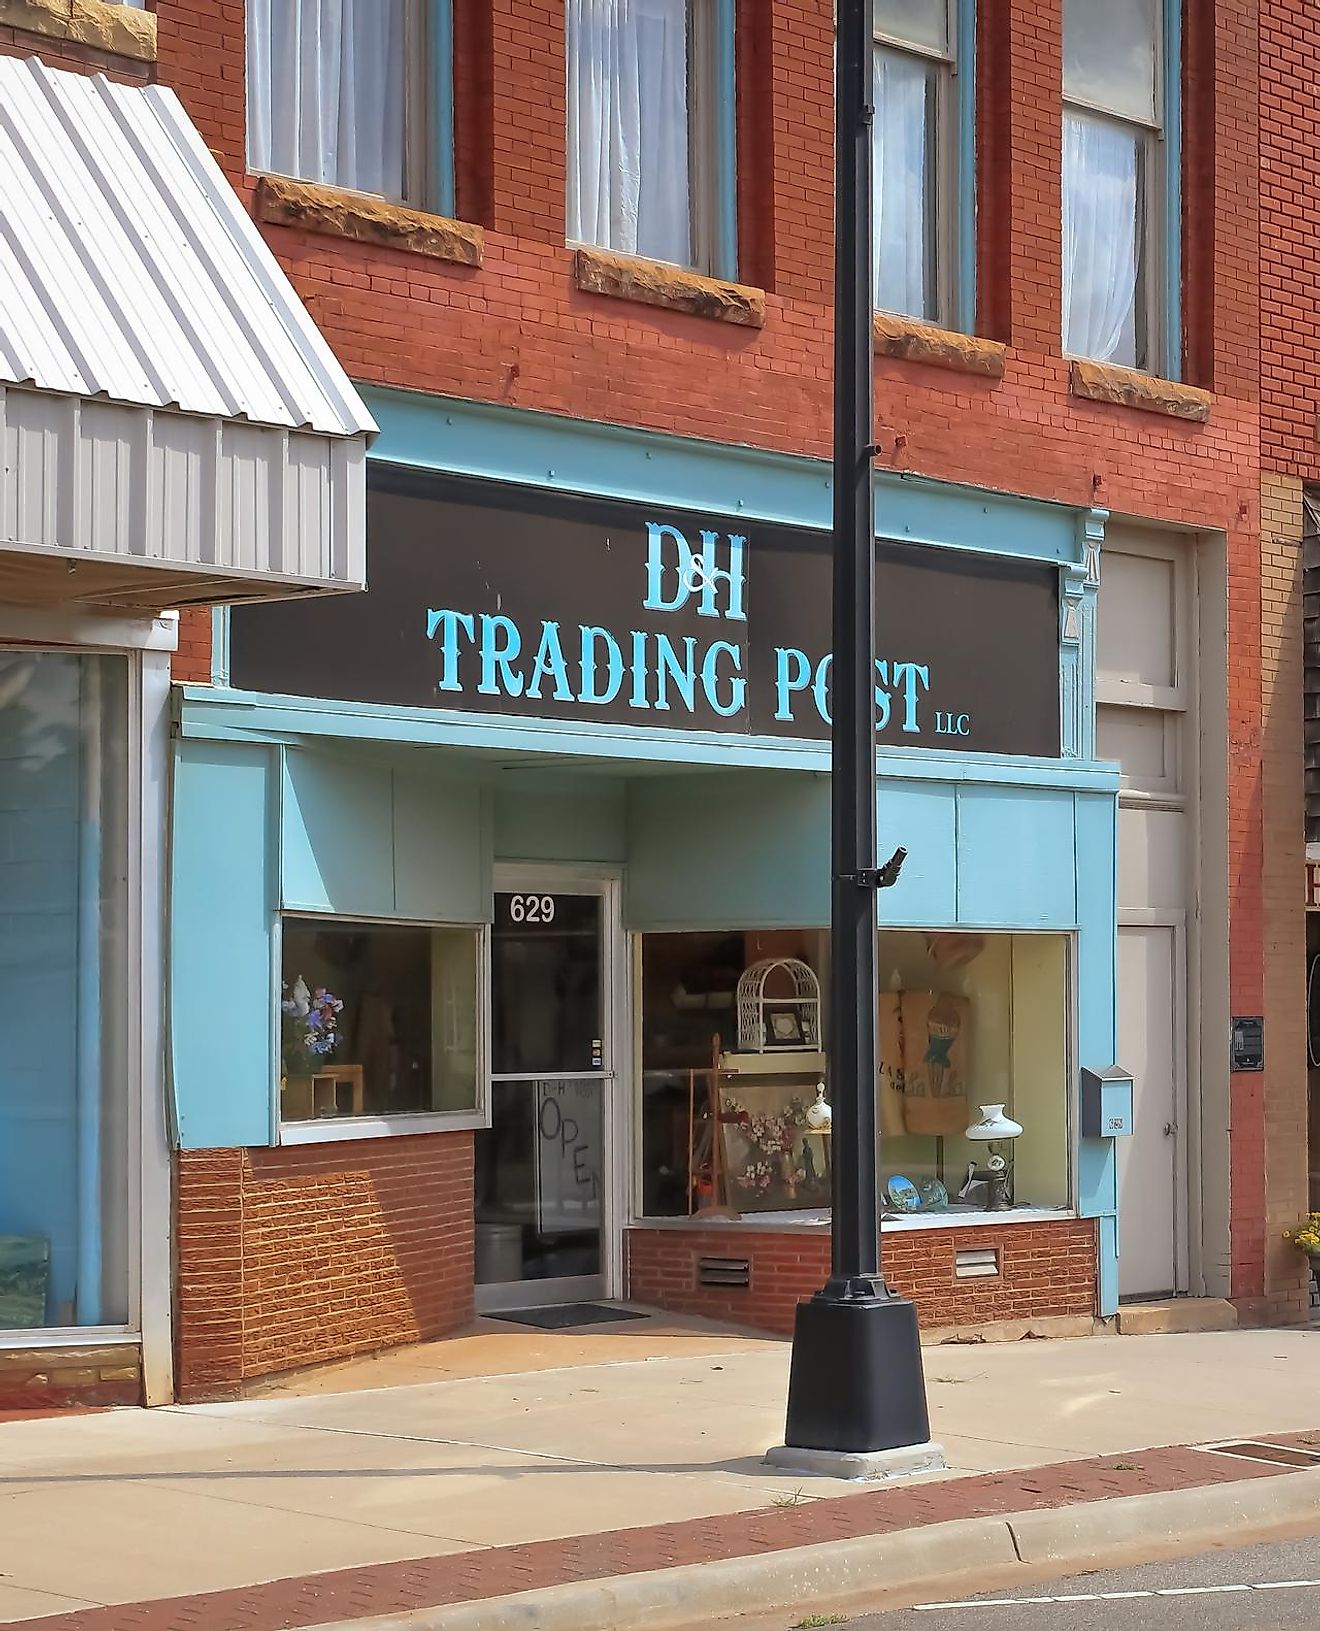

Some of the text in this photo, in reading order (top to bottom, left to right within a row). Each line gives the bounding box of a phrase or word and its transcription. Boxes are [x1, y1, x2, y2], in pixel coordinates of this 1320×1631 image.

[426, 608, 748, 717] TRADING
[934, 711, 971, 736] LLC
[509, 895, 555, 923] 629
